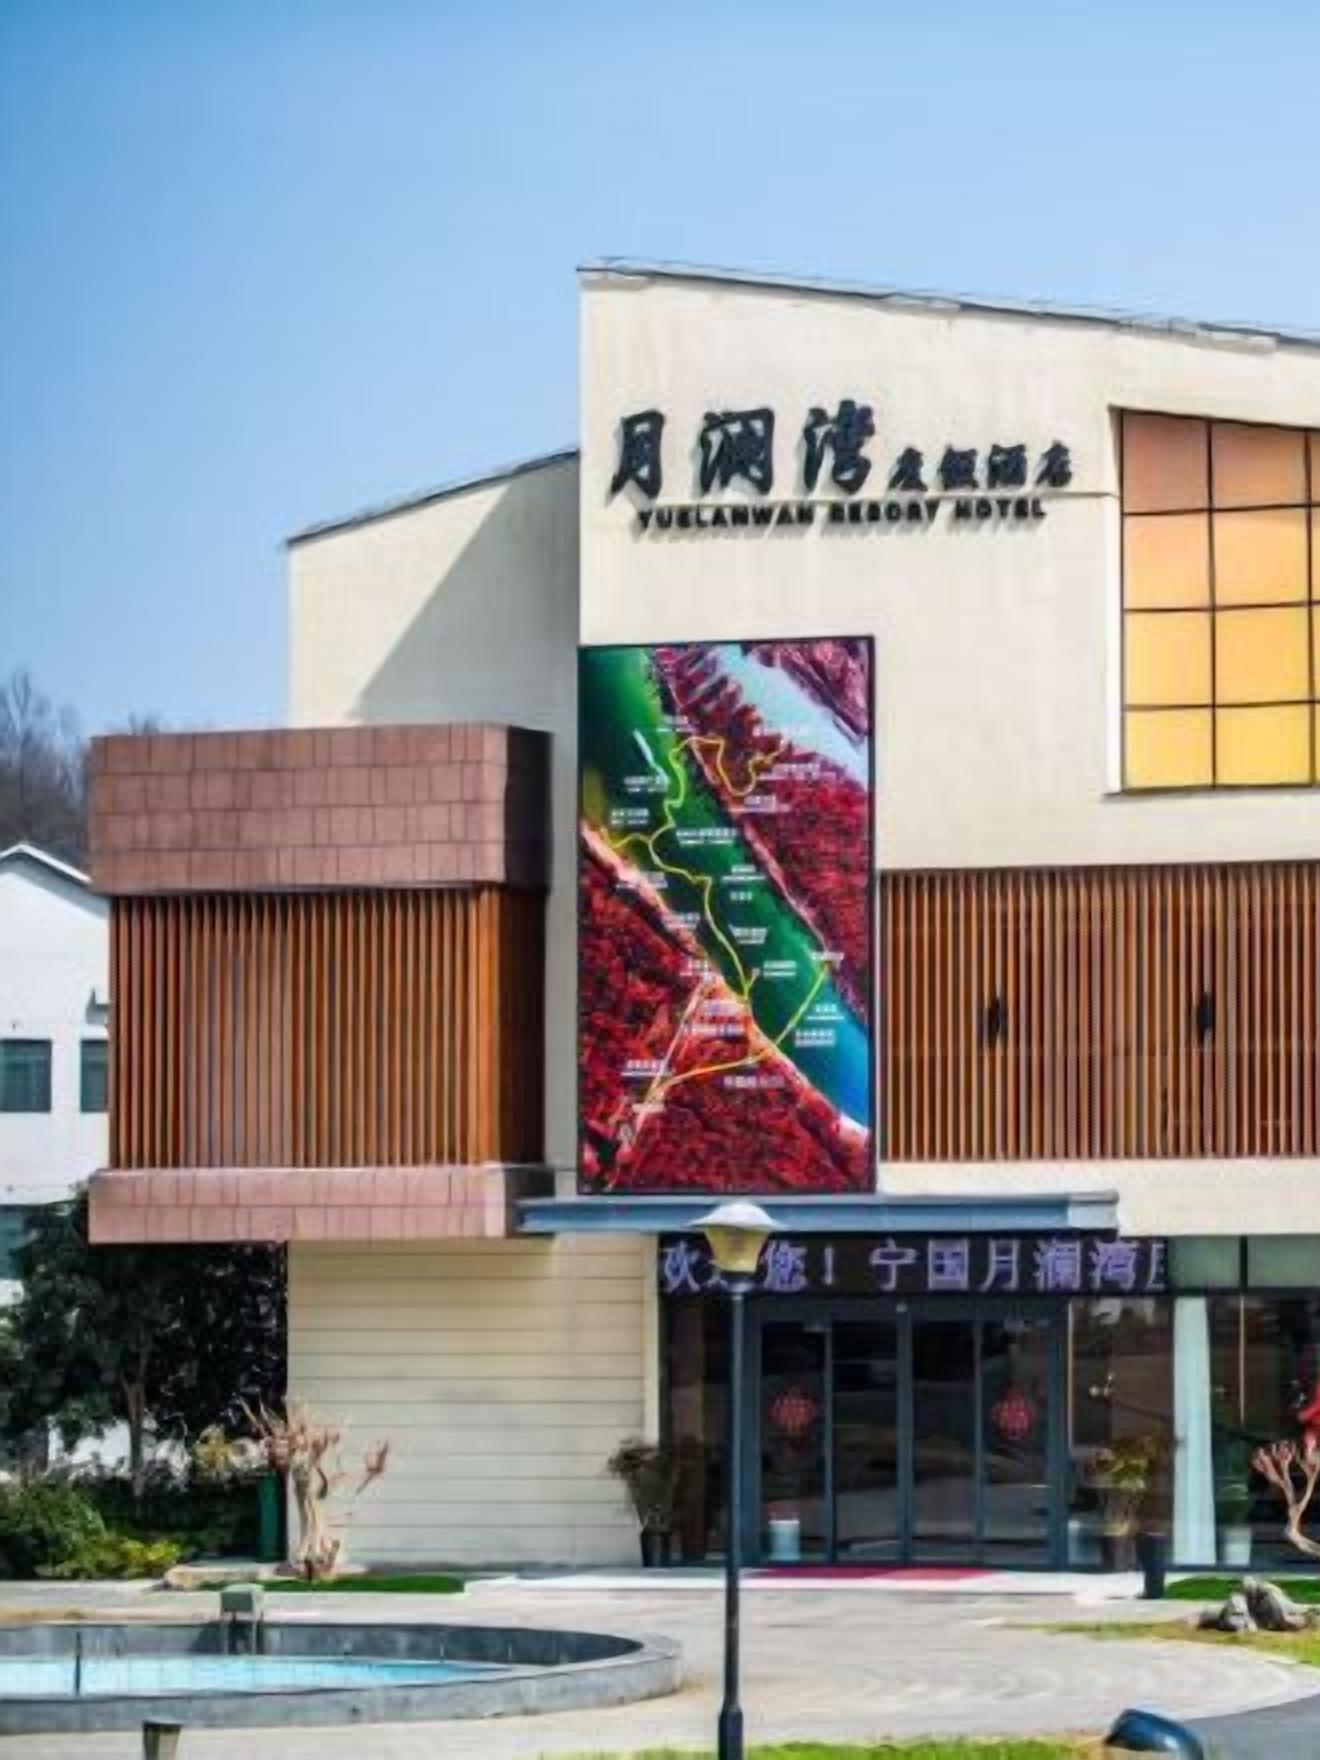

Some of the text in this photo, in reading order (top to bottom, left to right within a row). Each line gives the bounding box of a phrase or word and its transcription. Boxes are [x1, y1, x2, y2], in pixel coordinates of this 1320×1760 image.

[639, 497, 1046, 529] YUELANWAN RESORT HOTEL
[664, 1238, 1165, 1293] 欢您！宁国月澜湾
